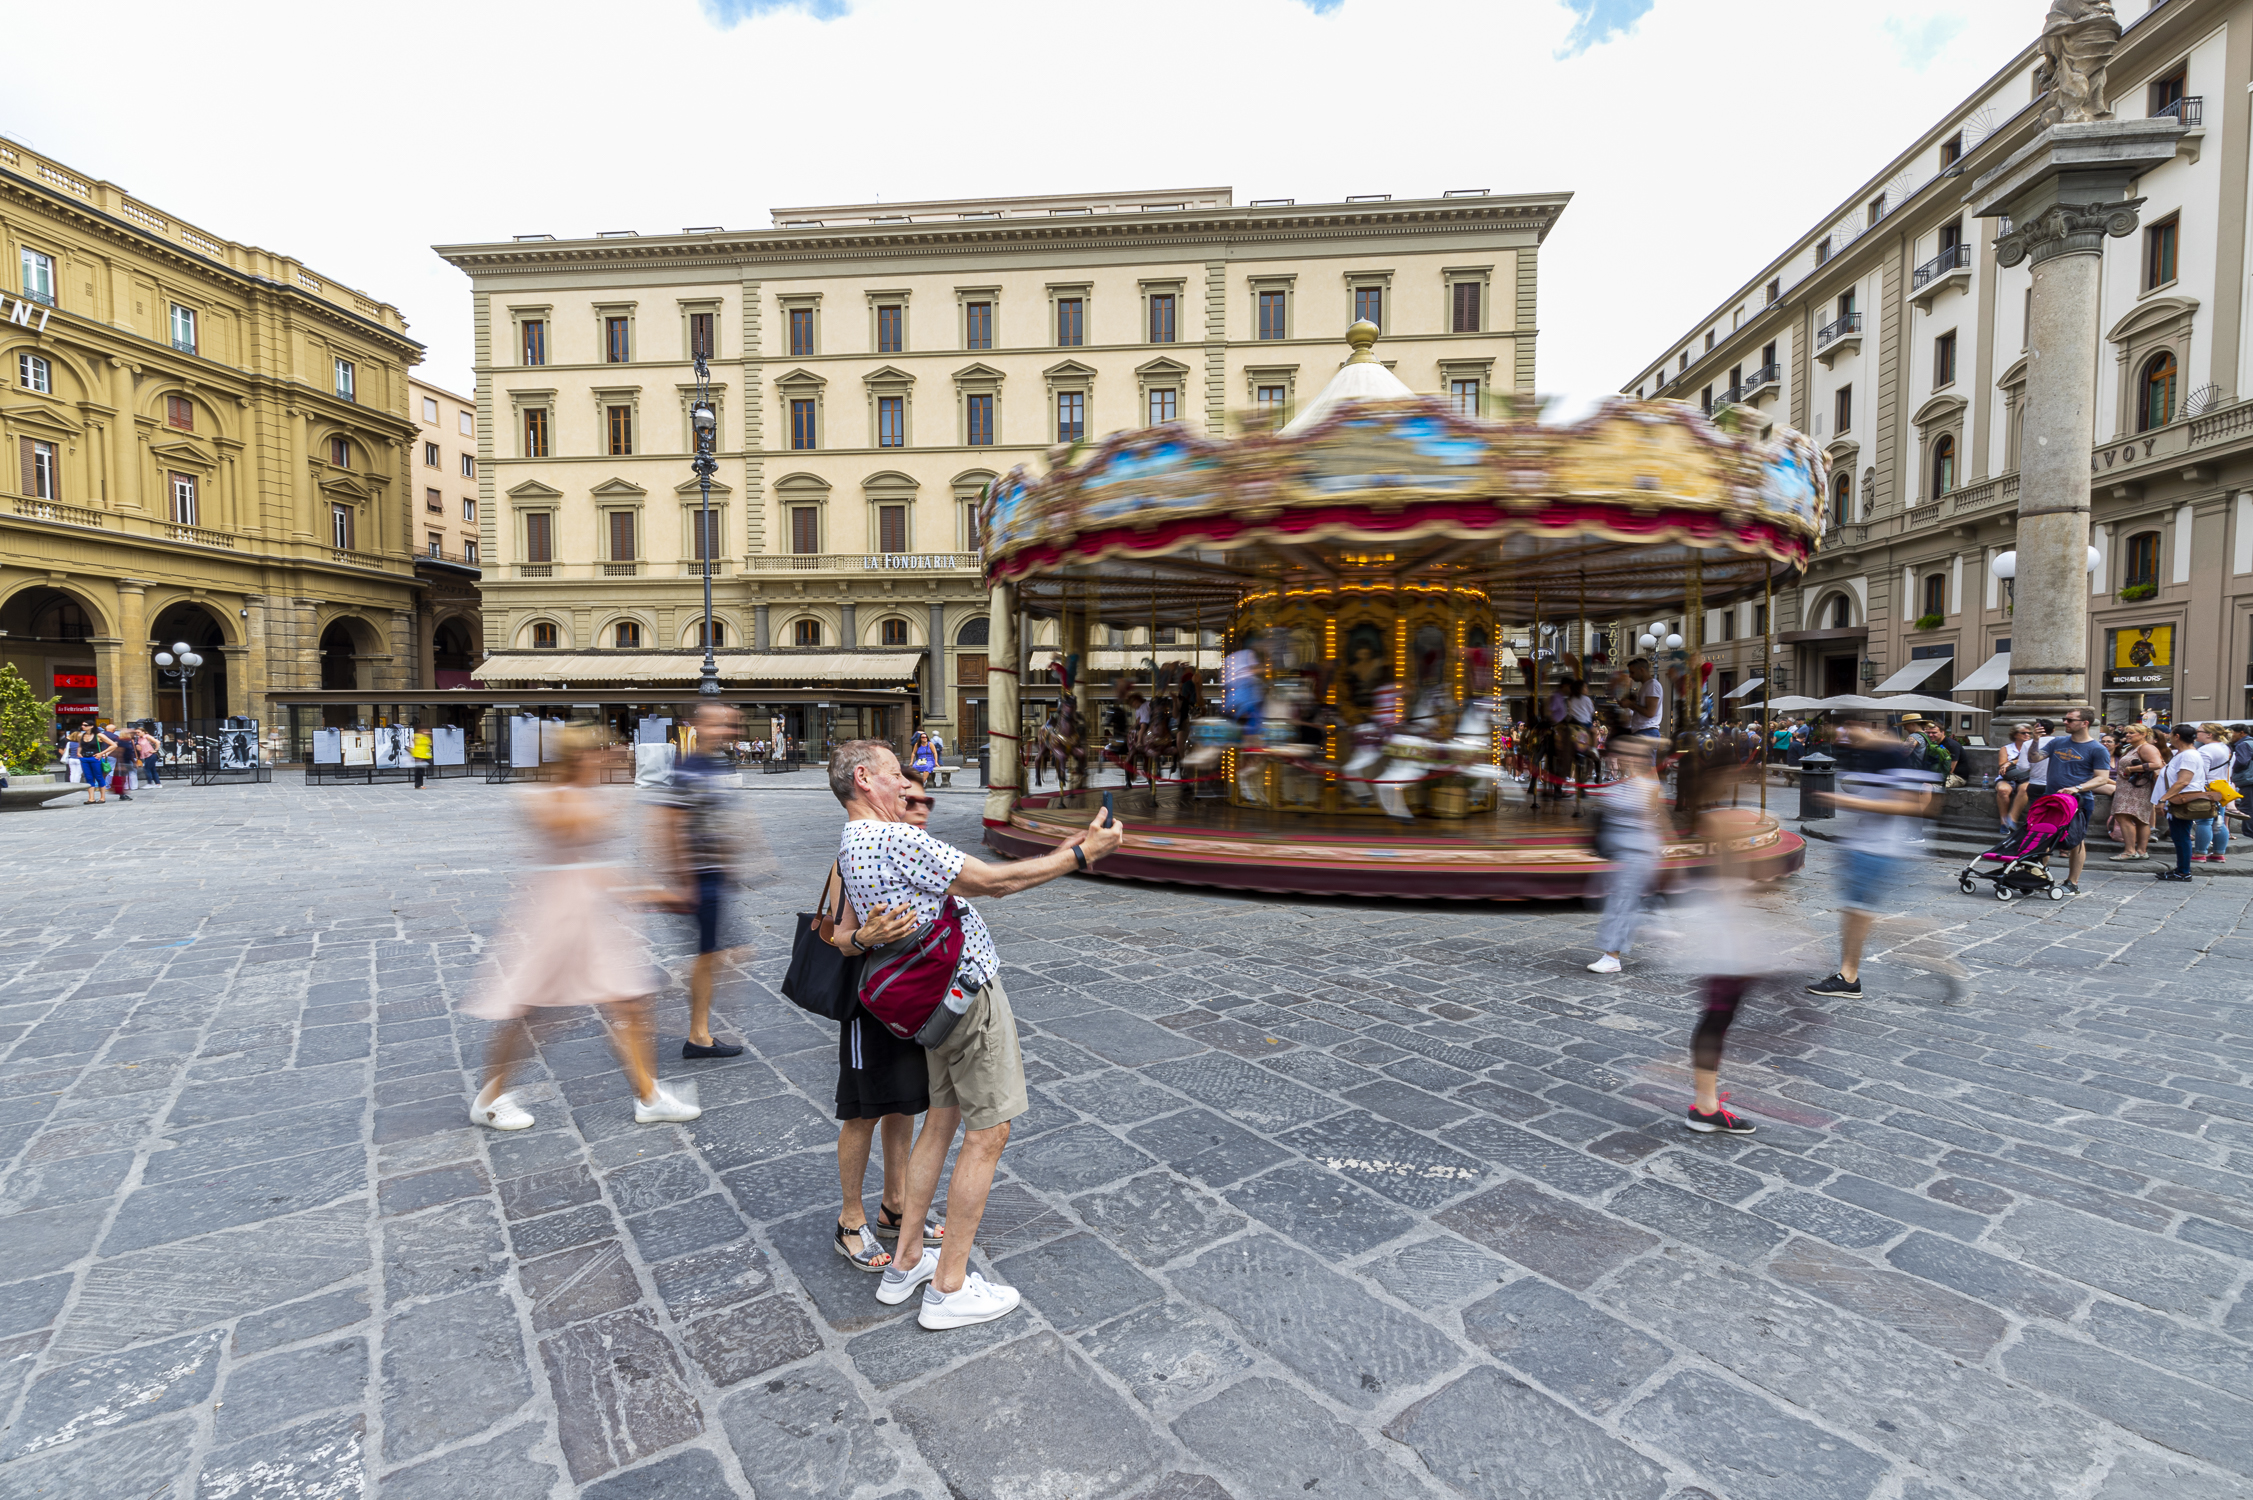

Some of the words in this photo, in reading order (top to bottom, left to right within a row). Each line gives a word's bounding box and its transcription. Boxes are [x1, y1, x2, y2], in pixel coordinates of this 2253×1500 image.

[0, 294, 50, 333] NI
[2091, 438, 2157, 472] AVOY
[863, 556, 879, 569] LA
[885, 553, 956, 569] FONDIARIA
[2112, 675, 2141, 683] MICHAEL
[2142, 674, 2161, 682] KORS
